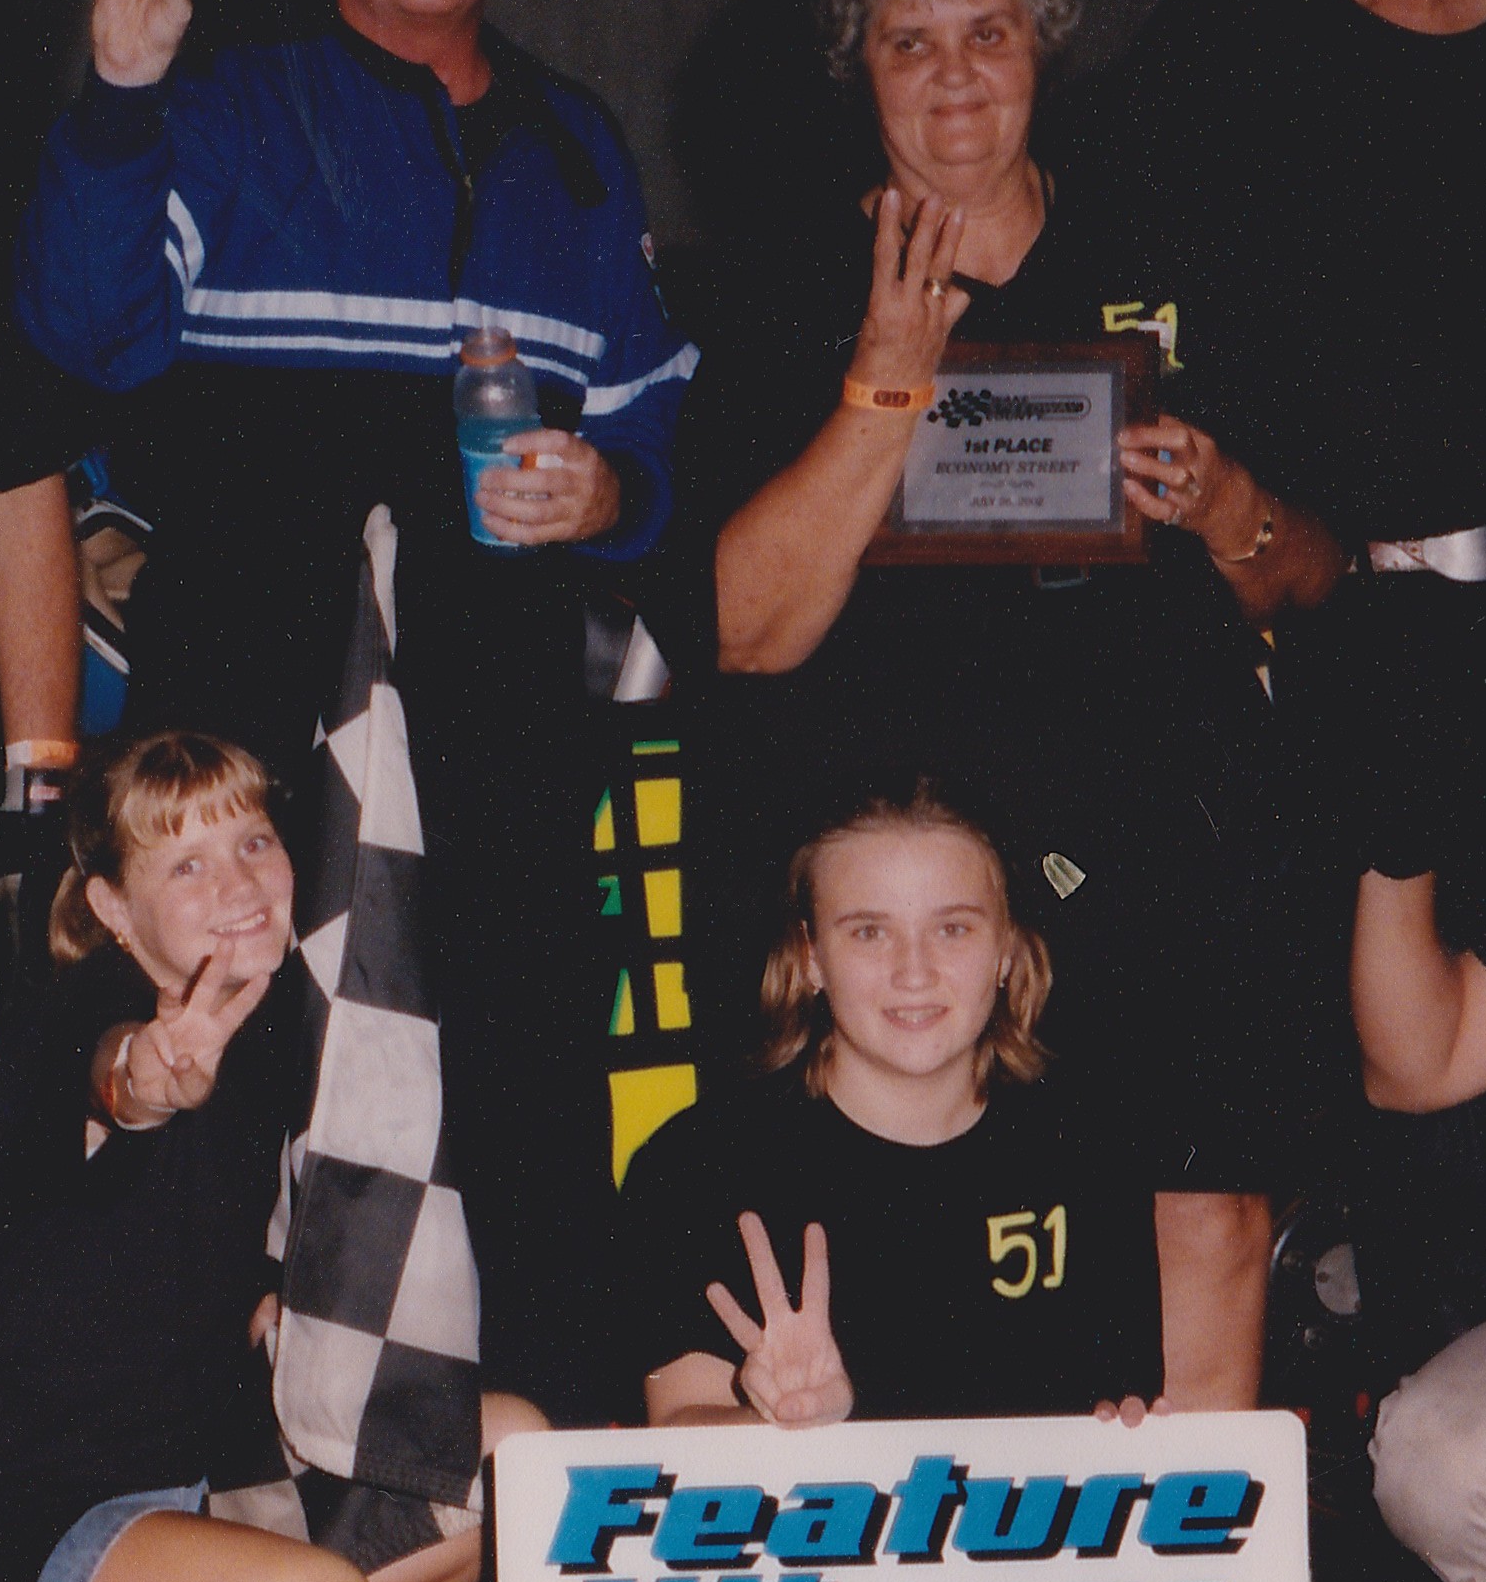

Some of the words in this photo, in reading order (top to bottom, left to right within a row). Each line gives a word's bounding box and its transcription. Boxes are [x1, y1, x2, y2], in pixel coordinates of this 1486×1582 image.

[935, 460, 1014, 475] ECONOMY
[1015, 460, 1080, 474] STREET
[965, 437, 990, 453] 1st
[993, 437, 1054, 453] PLACE
[986, 1205, 1067, 1298] 51
[545, 1454, 1266, 1575] Feature
